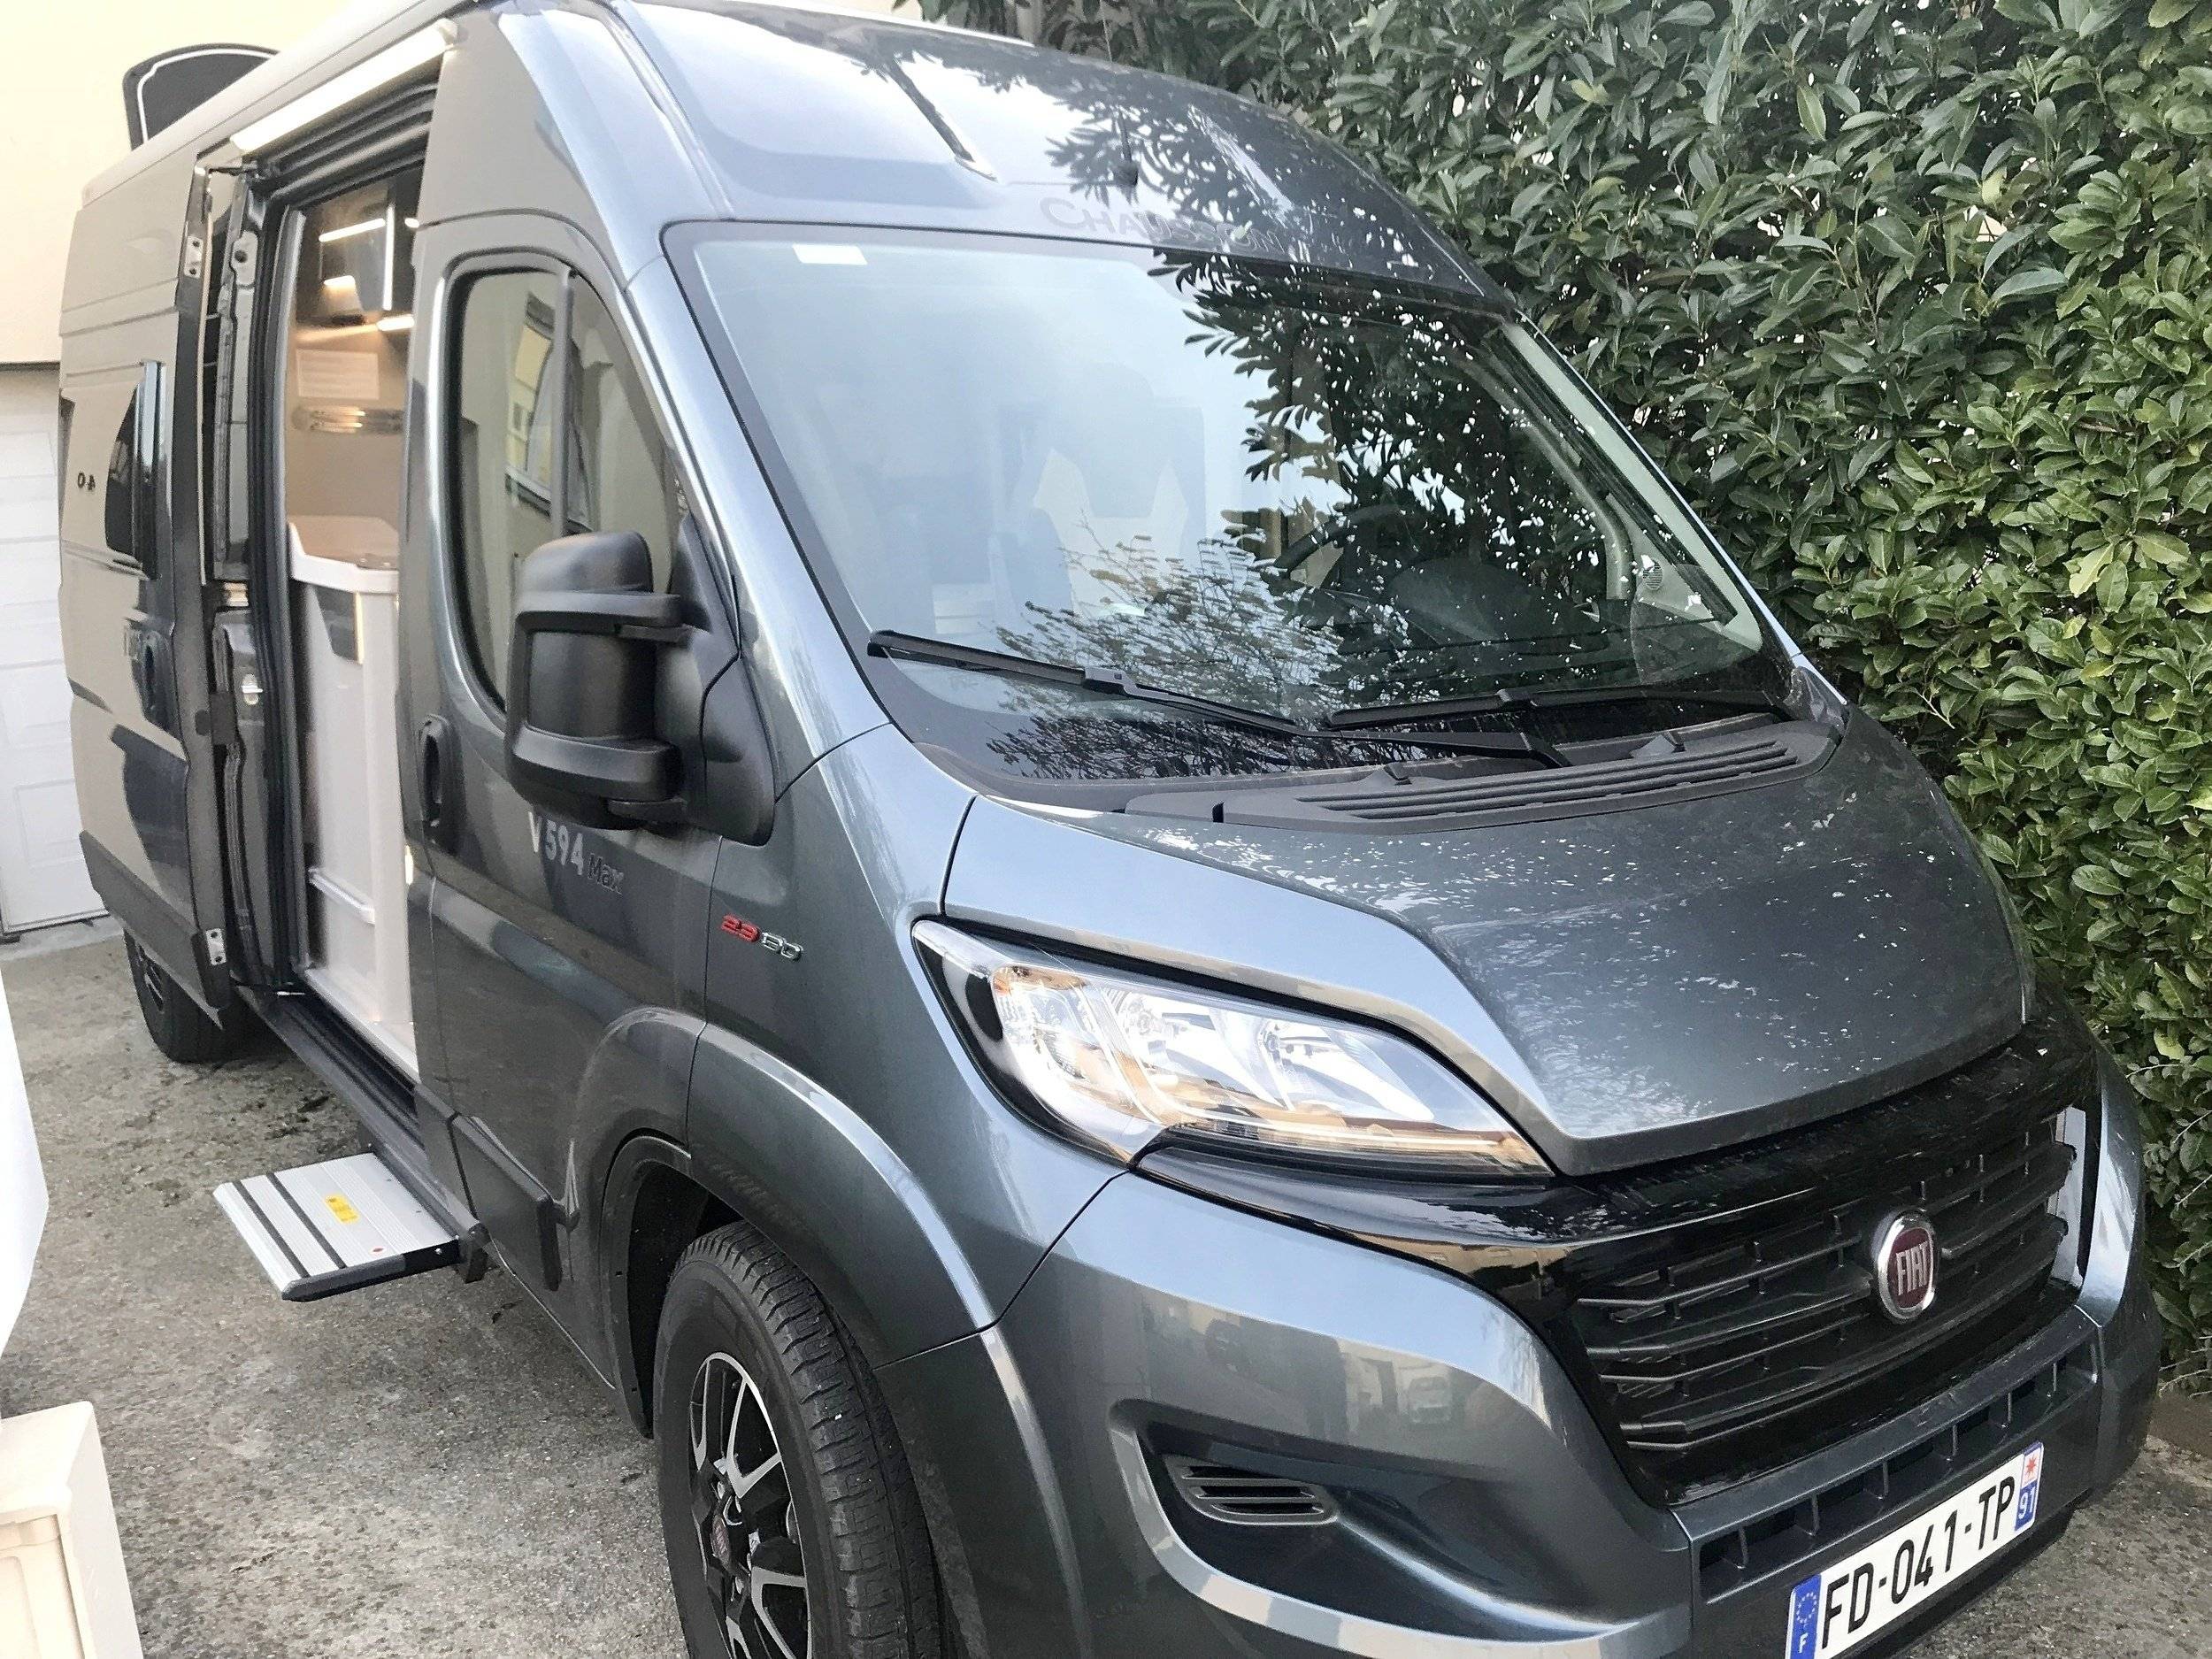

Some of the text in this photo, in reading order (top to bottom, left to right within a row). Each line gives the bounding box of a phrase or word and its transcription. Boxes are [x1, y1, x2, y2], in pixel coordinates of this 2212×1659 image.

[588, 852, 625, 895] Max
[1895, 1240, 1929, 1295] FIAT
[2018, 1486, 2036, 1519] 91
[1822, 1476, 2016, 1649] FD-041-TP
[1798, 1632, 1809, 1654] F
